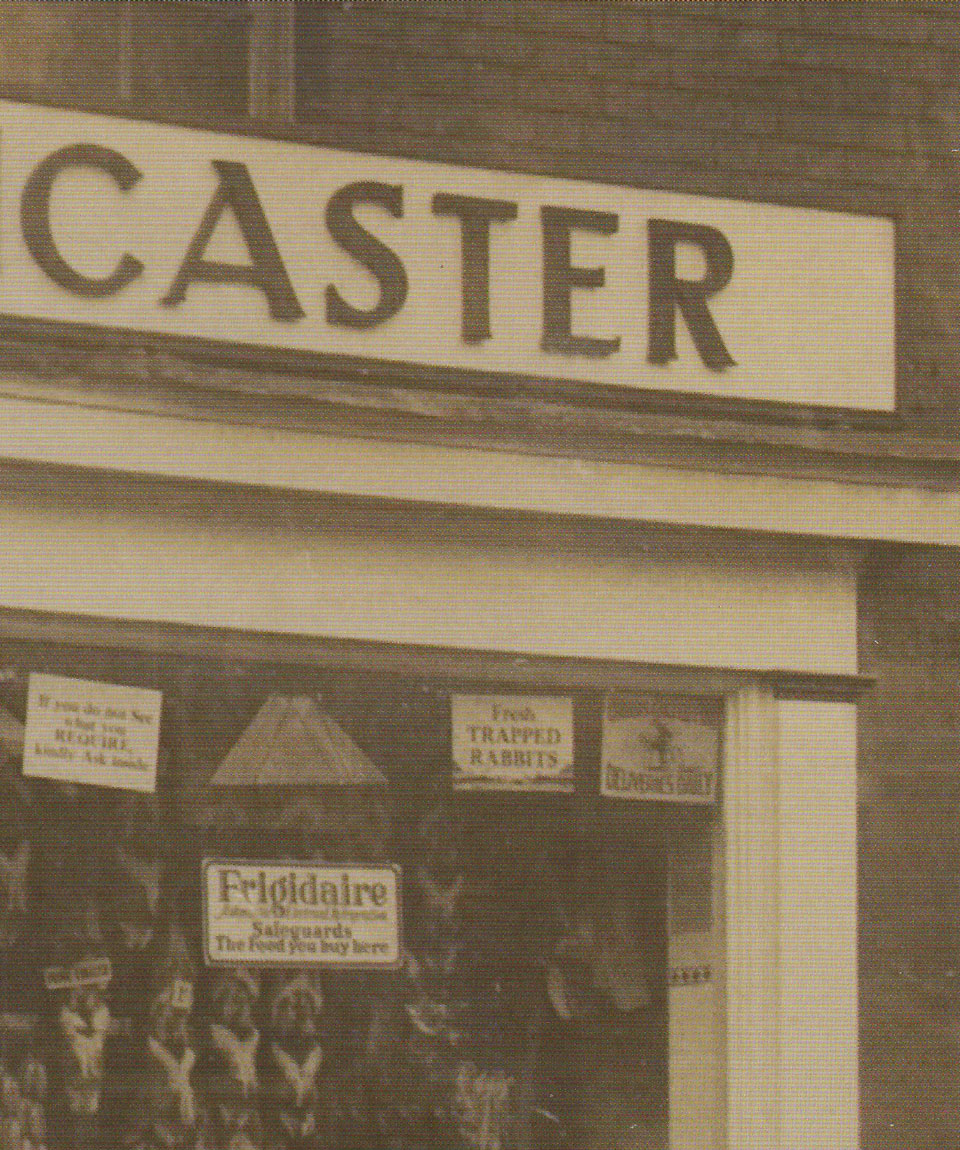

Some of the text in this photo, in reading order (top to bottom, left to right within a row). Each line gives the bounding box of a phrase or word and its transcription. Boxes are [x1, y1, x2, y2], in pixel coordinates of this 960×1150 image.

[55, 701, 79, 712] you
[83, 703, 100, 716] do
[105, 708, 126, 719] not
[132, 710, 153, 724] See
[492, 704, 536, 721] Fresh
[102, 724, 126, 737] you
[466, 725, 561, 744] TRAPPED
[470, 748, 558, 768] RABBITS
[218, 869, 387, 917] Frigidaire
[252, 921, 352, 940] Safeguards
[216, 936, 245, 952] The
[289, 939, 316, 955] you
[320, 939, 350, 956] buy
[352, 939, 389, 954] here
